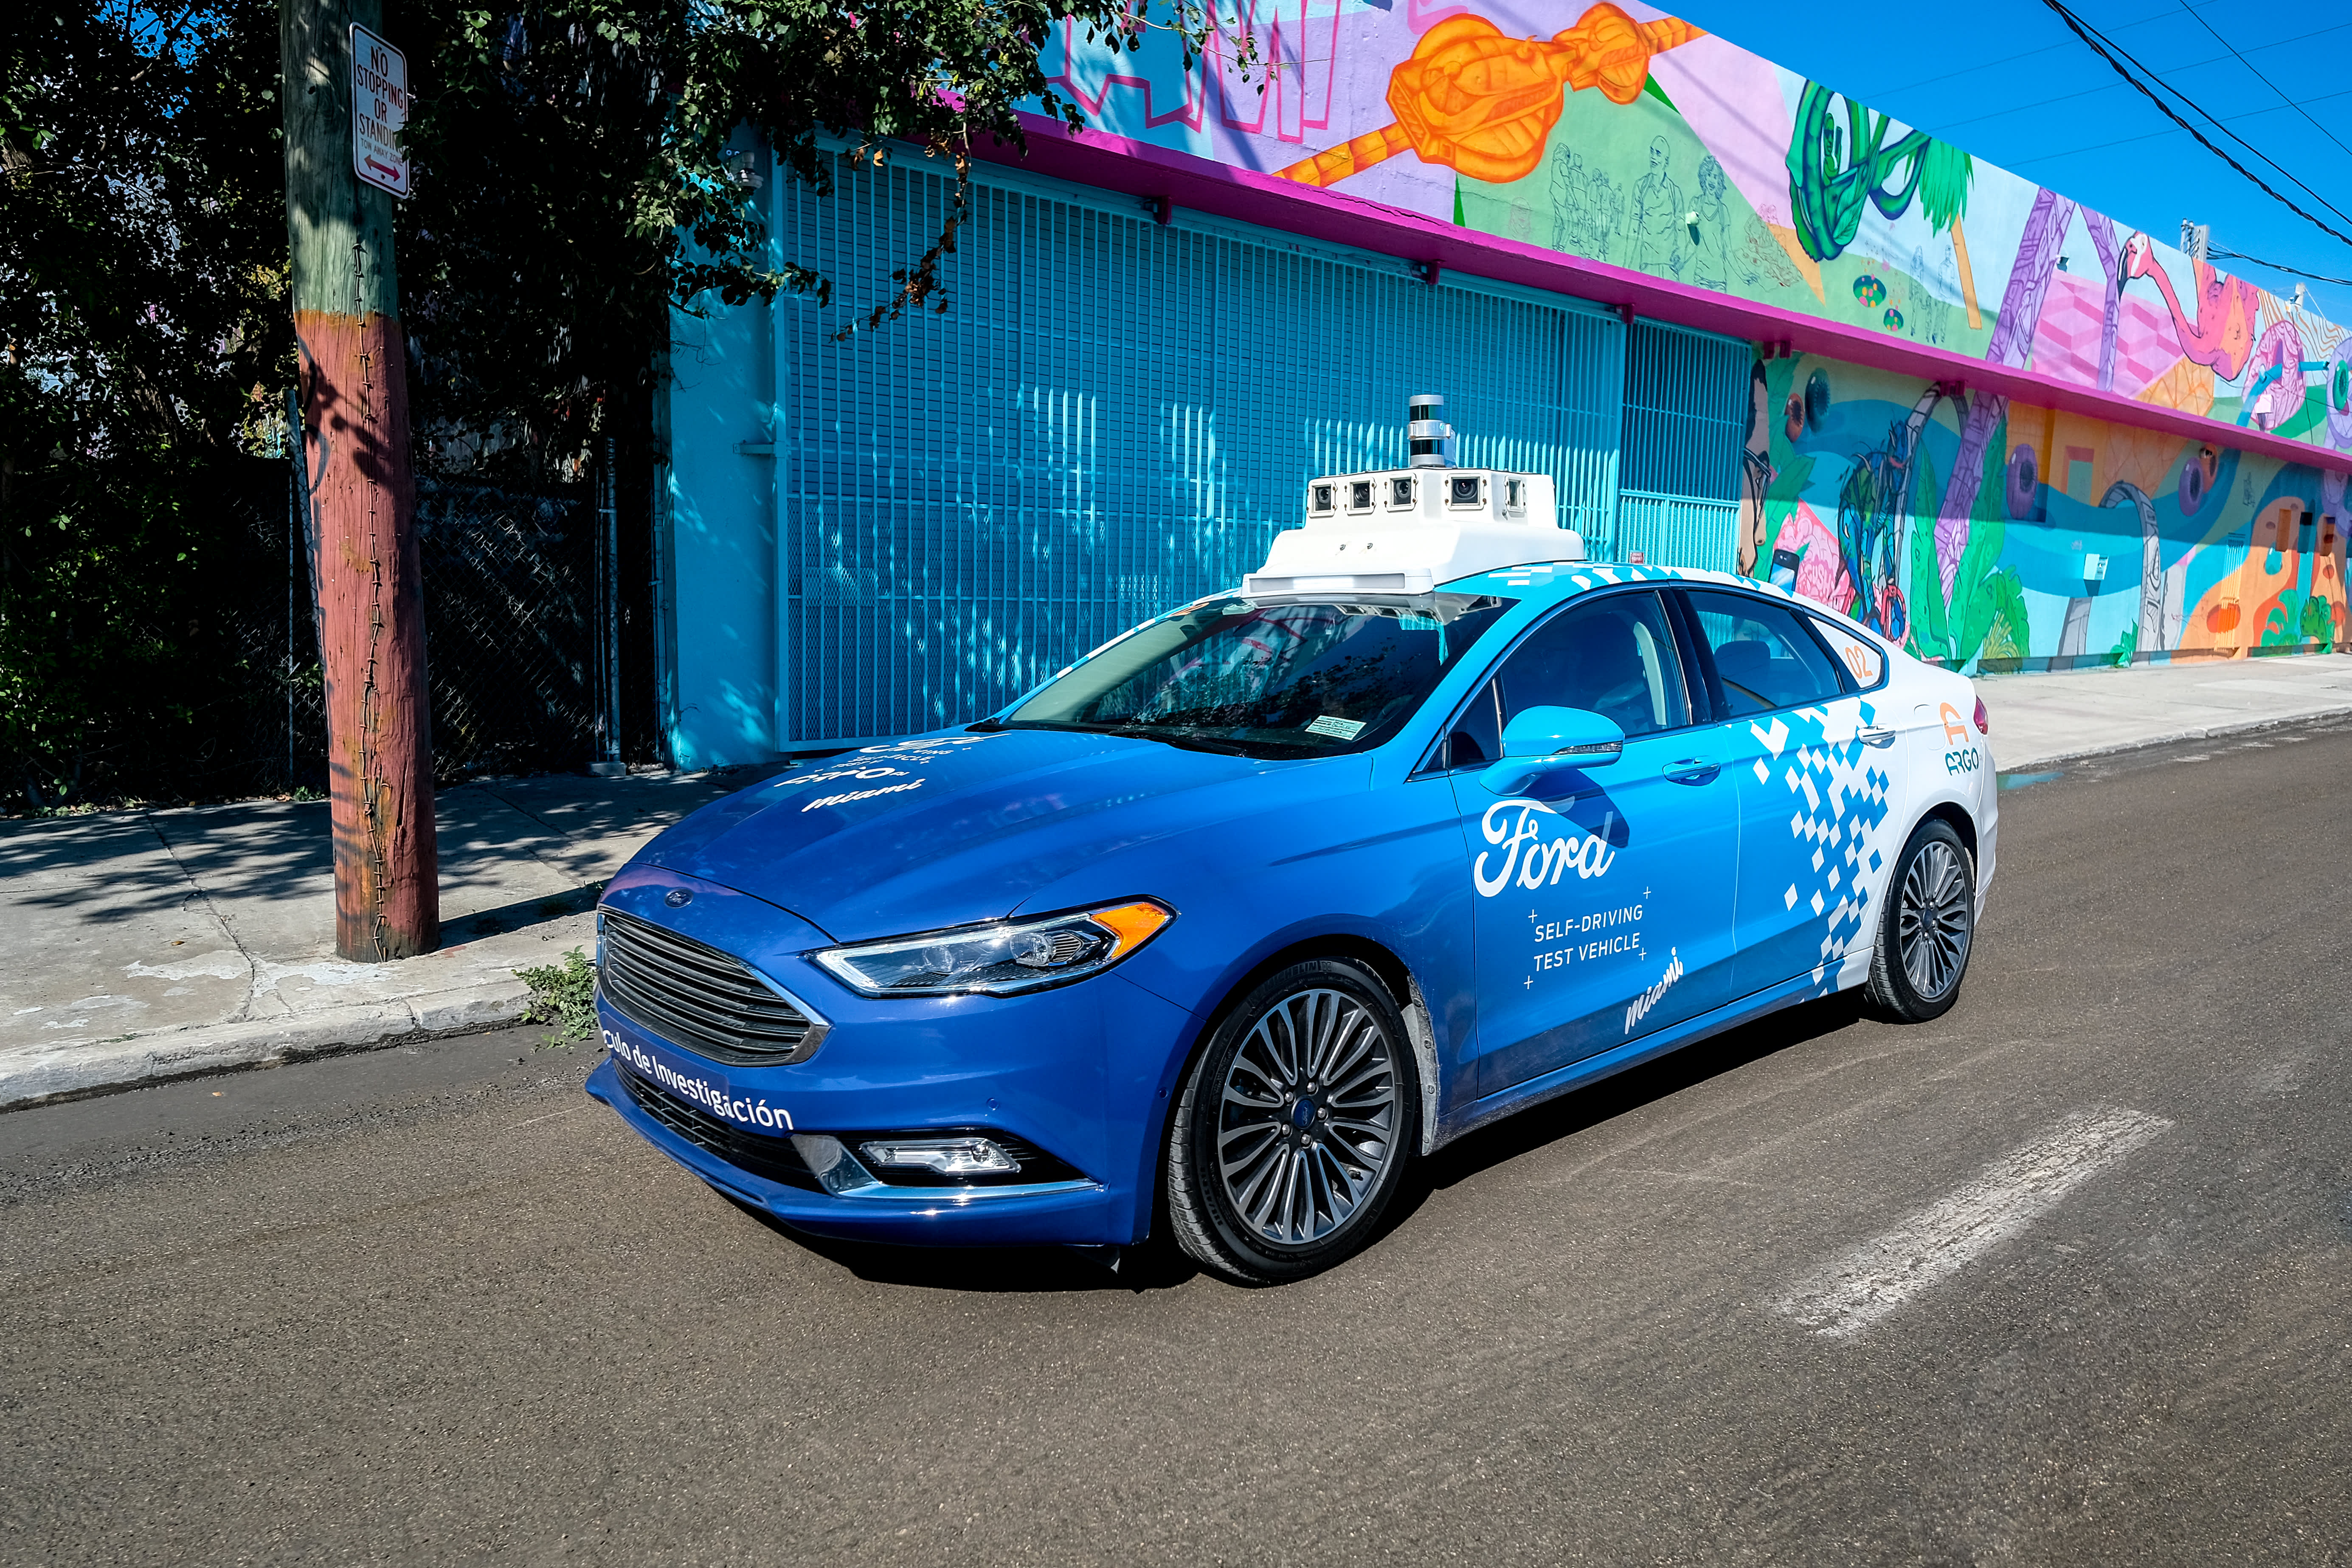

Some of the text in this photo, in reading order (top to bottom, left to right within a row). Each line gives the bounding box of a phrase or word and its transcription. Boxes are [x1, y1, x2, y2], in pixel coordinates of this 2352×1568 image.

[371, 46, 388, 77] NO
[357, 64, 403, 109] STOPPING
[374, 98, 387, 123] OR
[361, 138, 402, 166] TOW AWAY ZONE
[1845, 645, 1873, 679] 02
[1945, 747, 1979, 776] ARGO
[801, 778, 926, 813] miami
[1474, 796, 1616, 898] Ford
[1534, 904, 1643, 943] SELF-DRIVING
[1533, 932, 1640, 972] TEST VEHICLE
[1624, 946, 1684, 1034] miami
[632, 1045, 653, 1075] de
[652, 1056, 794, 1130] Investigación
